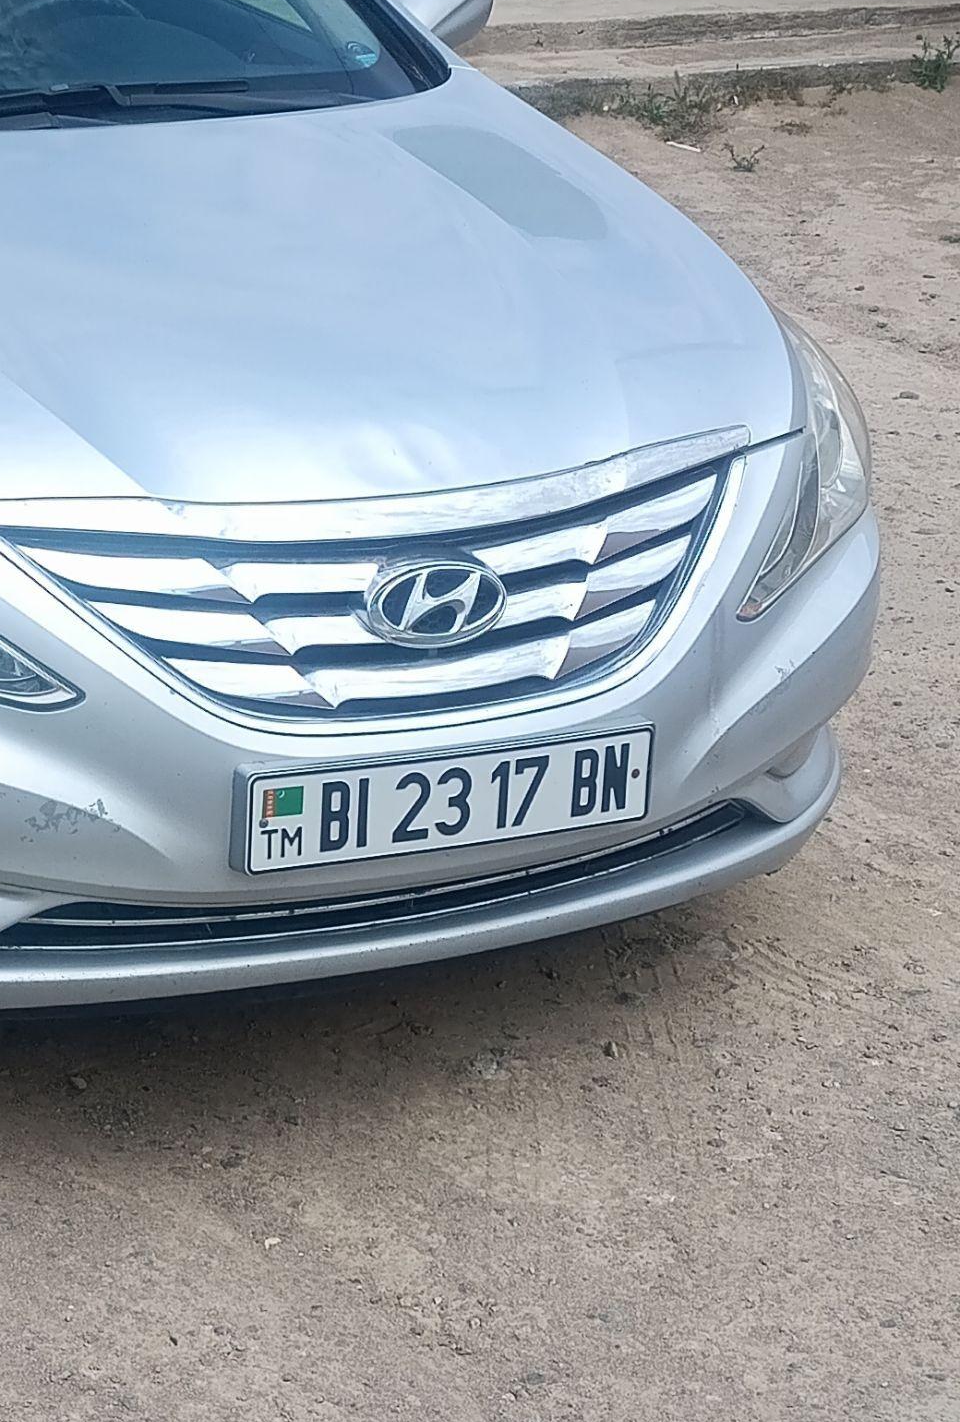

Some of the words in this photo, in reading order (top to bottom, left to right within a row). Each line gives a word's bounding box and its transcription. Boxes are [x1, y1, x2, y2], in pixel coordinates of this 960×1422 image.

[319, 778, 369, 852] BI
[571, 743, 630, 817] BN
[261, 827, 303, 861] TM
